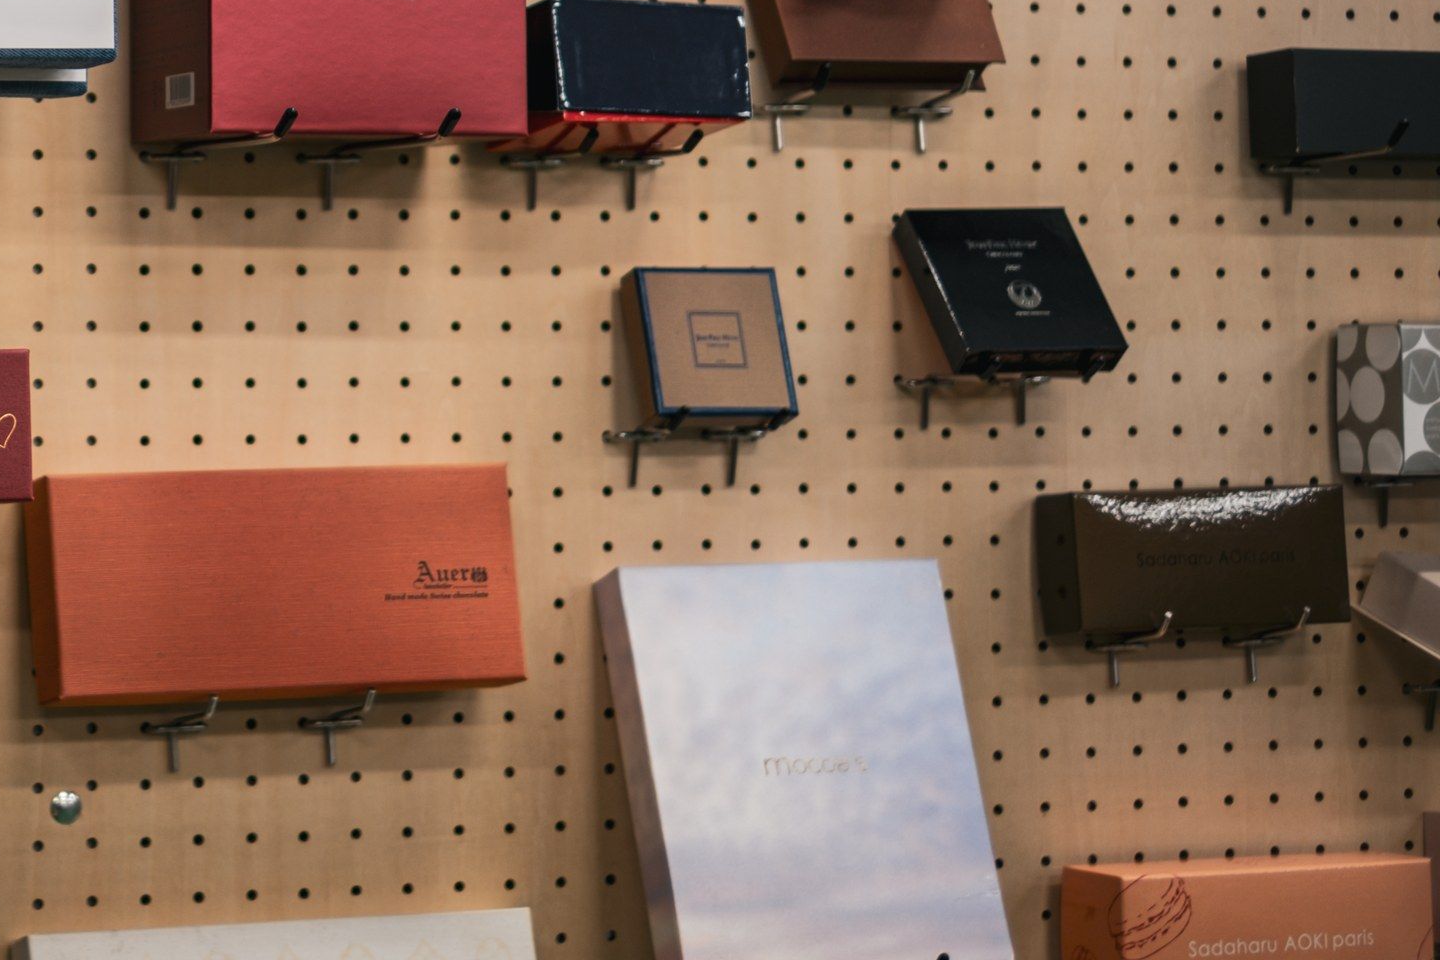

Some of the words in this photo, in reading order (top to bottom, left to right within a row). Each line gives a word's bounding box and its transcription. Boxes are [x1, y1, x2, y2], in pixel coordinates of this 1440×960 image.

[1188, 938, 1277, 958] Sadaharu
[1284, 933, 1329, 952] AOKI
[1332, 929, 1375, 951] paris
